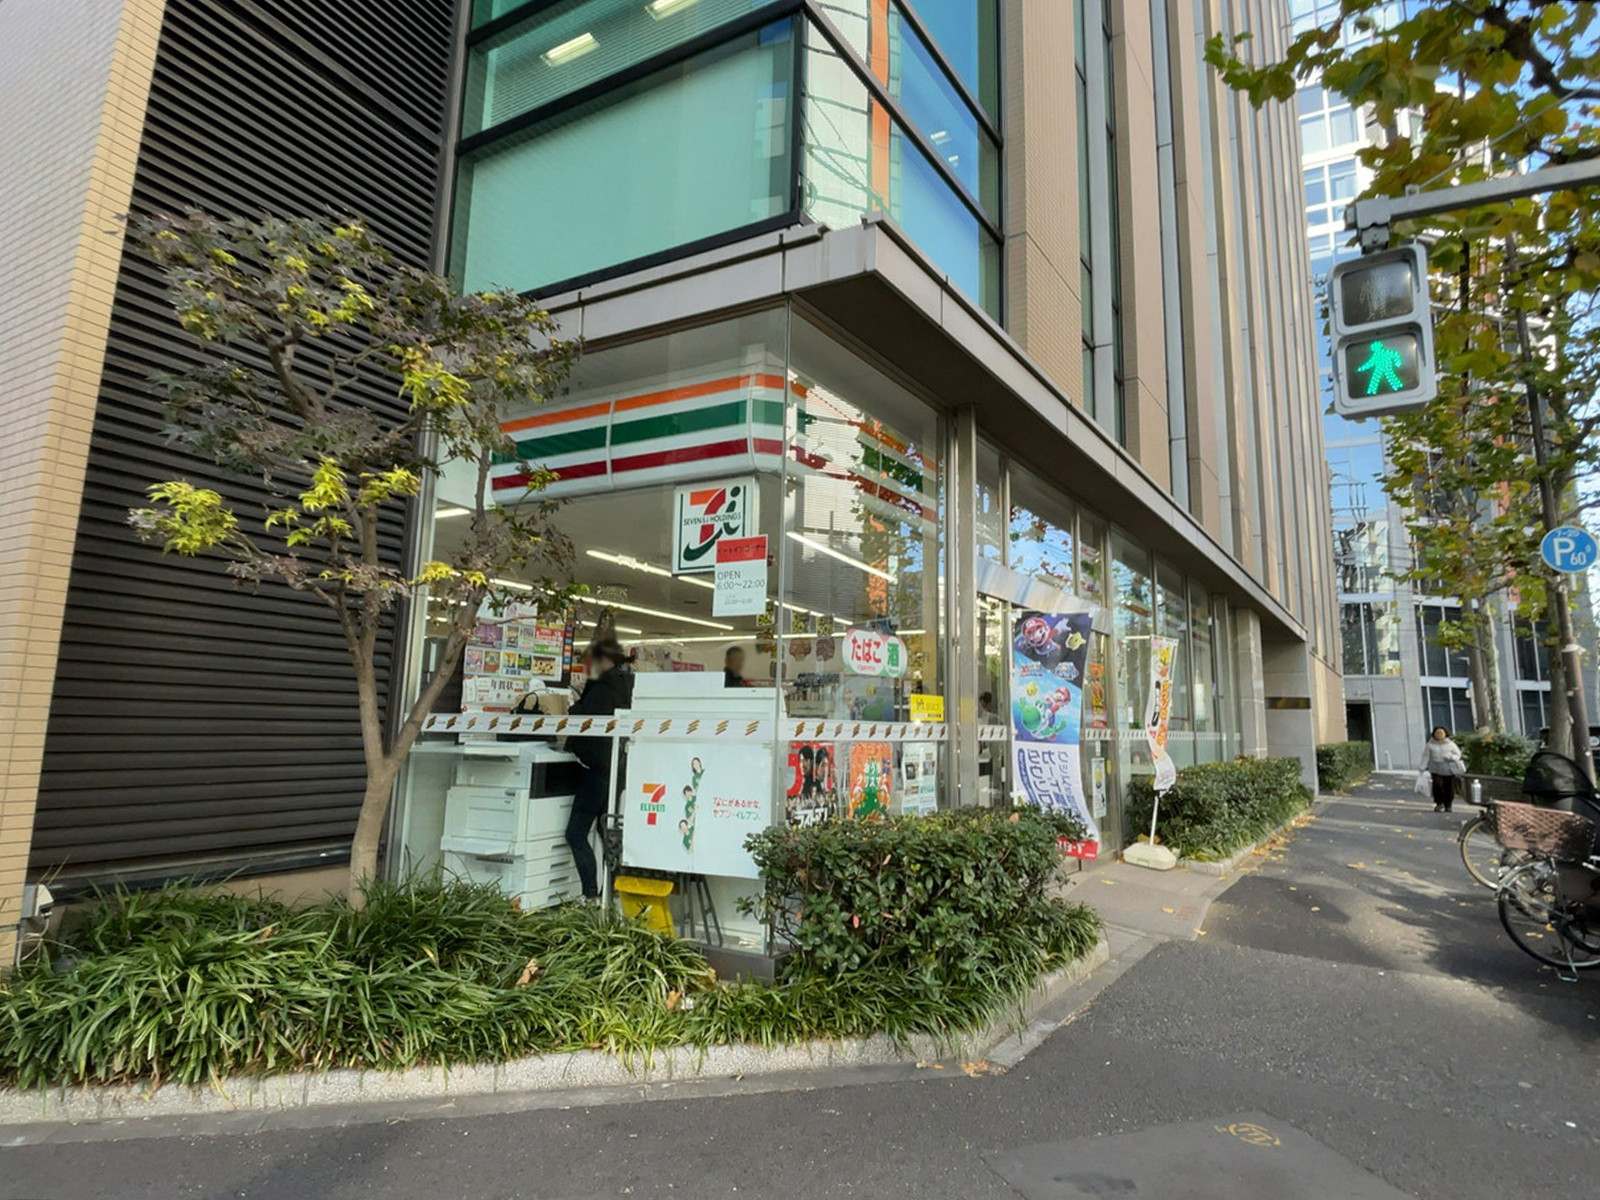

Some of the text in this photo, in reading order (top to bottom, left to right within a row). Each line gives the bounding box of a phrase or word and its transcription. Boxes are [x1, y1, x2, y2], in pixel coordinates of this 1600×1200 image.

[710, 512, 742, 523] HOLDINGS
[1553, 537, 1576, 566] P
[1570, 551, 1587, 566] 60
[717, 570, 741, 581] OPEN
[851, 635, 882, 664] たばこ
